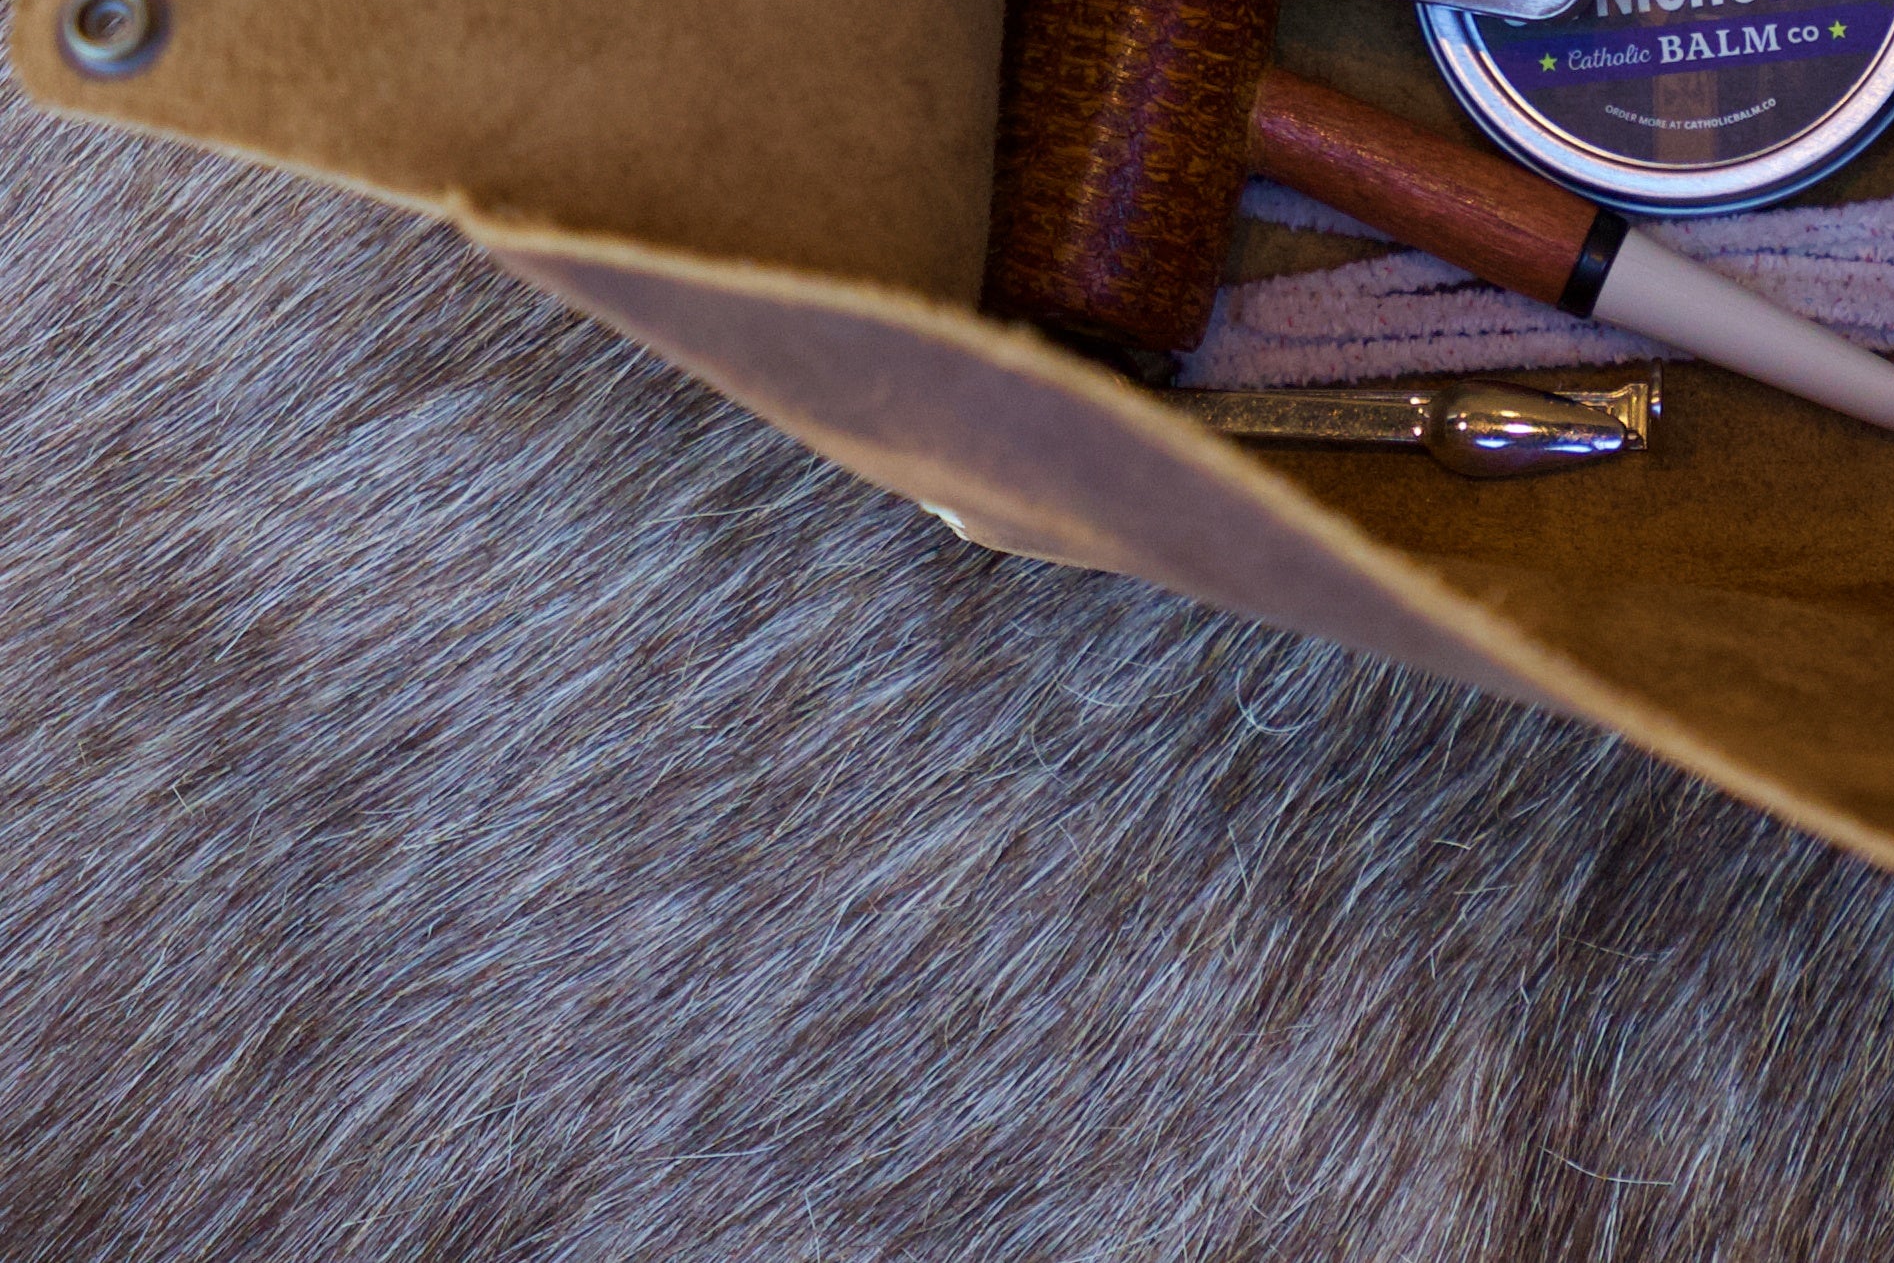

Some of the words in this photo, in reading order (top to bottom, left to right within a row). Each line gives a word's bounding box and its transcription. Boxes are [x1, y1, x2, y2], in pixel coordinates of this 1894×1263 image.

[1567, 46, 1651, 71] Catholic
[1658, 24, 1782, 64] BALM
[1604, 104, 1637, 122] ORDER
[1638, 115, 1667, 129] MORE
[1669, 120, 1682, 129] AT
[1683, 97, 1777, 130] CATHOLICBALM.CO
